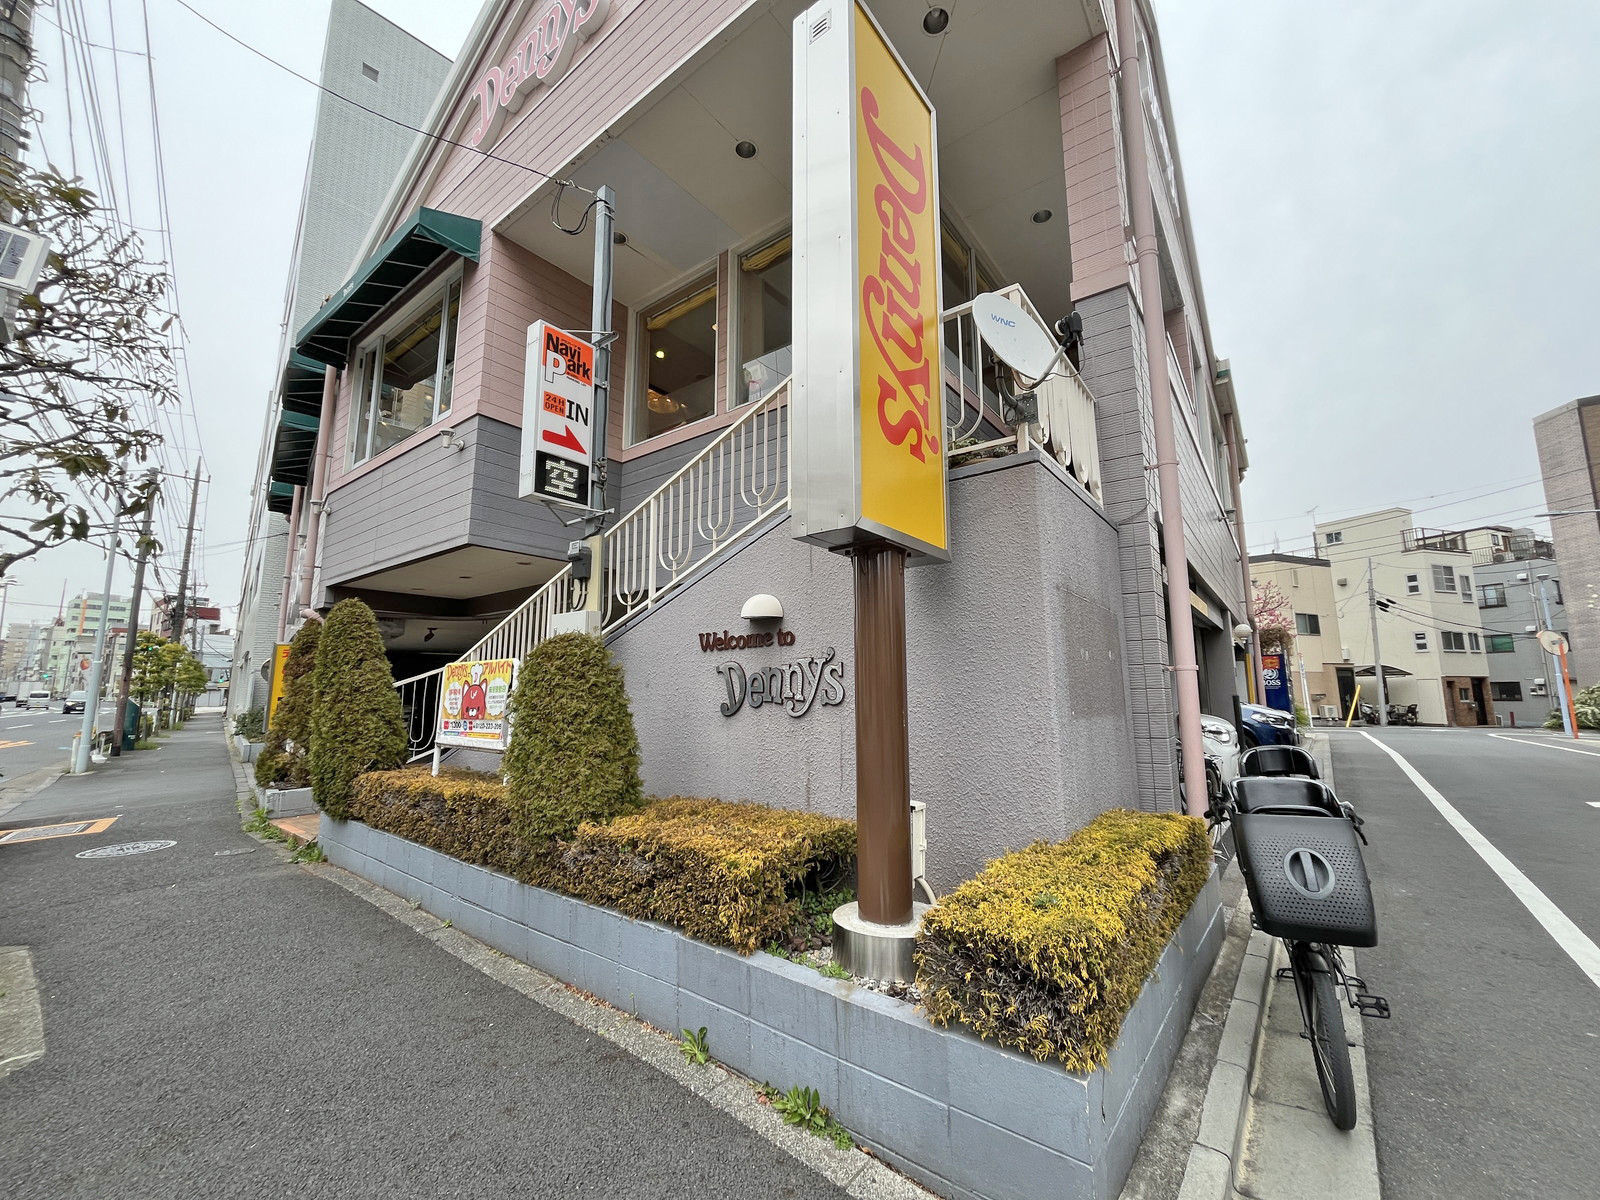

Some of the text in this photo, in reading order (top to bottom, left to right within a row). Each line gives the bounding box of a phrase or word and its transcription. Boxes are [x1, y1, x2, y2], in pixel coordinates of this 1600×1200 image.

[861, 86, 939, 464] Denny's
[991, 313, 1016, 328] WNC
[546, 332, 582, 364] Navi
[544, 349, 591, 384] Park
[544, 401, 564, 414] OPEN
[566, 399, 589, 426] IN
[545, 460, 579, 499] 空
[698, 628, 796, 652] Welcome to
[716, 646, 845, 718] Denny's
